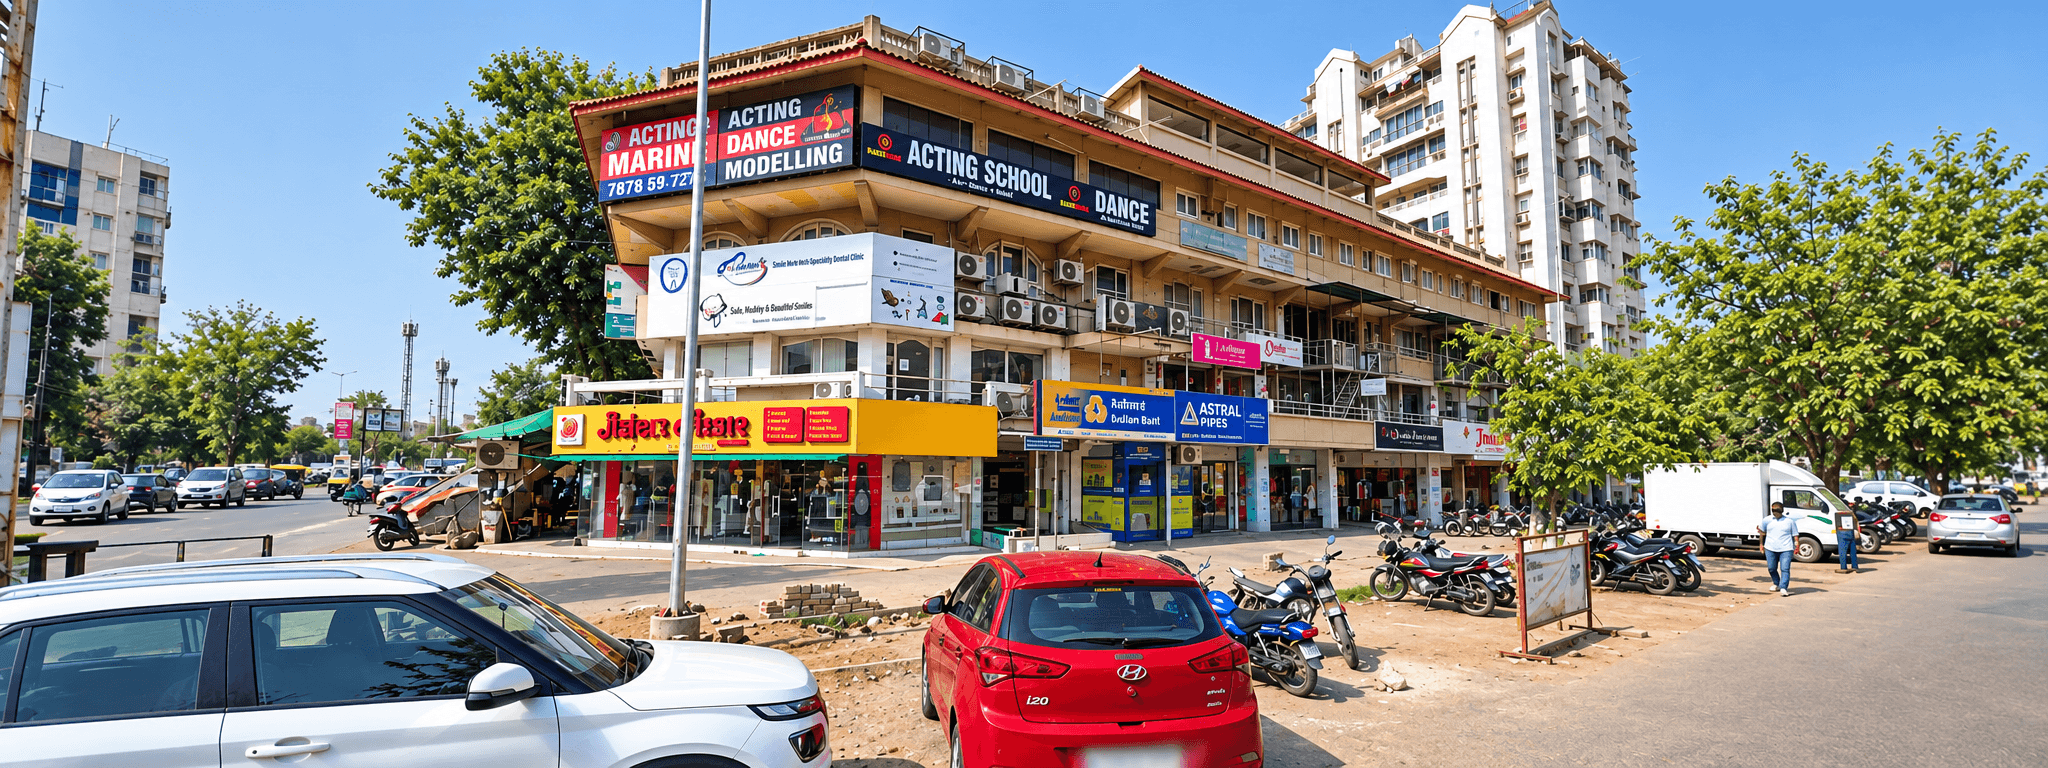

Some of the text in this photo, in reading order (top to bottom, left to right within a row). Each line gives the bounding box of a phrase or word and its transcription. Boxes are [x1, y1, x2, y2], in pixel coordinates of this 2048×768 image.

[728, 97, 802, 130] ACTING
[727, 124, 796, 155] DANCE
[725, 142, 843, 180] MODELLING
[907, 139, 979, 181] ACTING
[984, 159, 1052, 200] SCHOOL
[608, 178, 643, 197] 7878
[1095, 189, 1149, 225] DANCE
[850, 252, 864, 261] Clinic
[1199, 402, 1241, 418] ASTRAL
[1200, 417, 1228, 428] PIPES
[1026, 695, 1049, 706] i20
